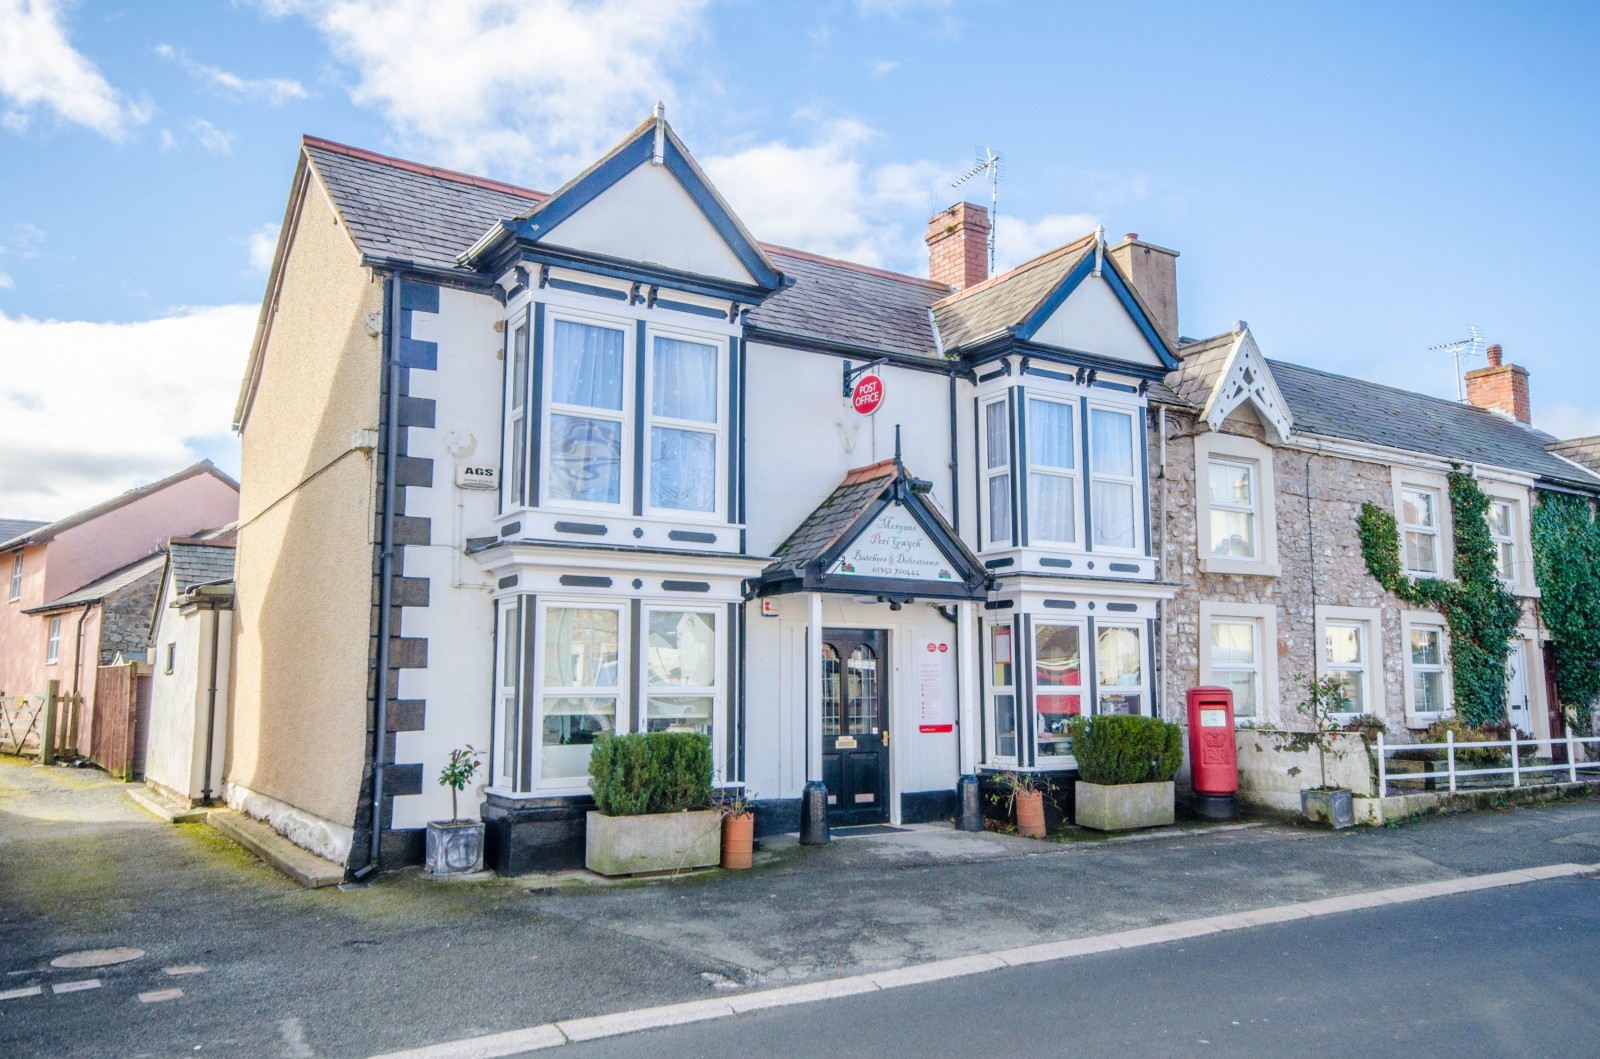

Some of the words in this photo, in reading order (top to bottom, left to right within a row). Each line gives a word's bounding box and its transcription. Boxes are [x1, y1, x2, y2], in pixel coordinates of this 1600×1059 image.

[860, 381, 878, 395] POST
[855, 391, 879, 406] OFFICE
[464, 467, 493, 476] AGS
[853, 550, 886, 562] Butchers
